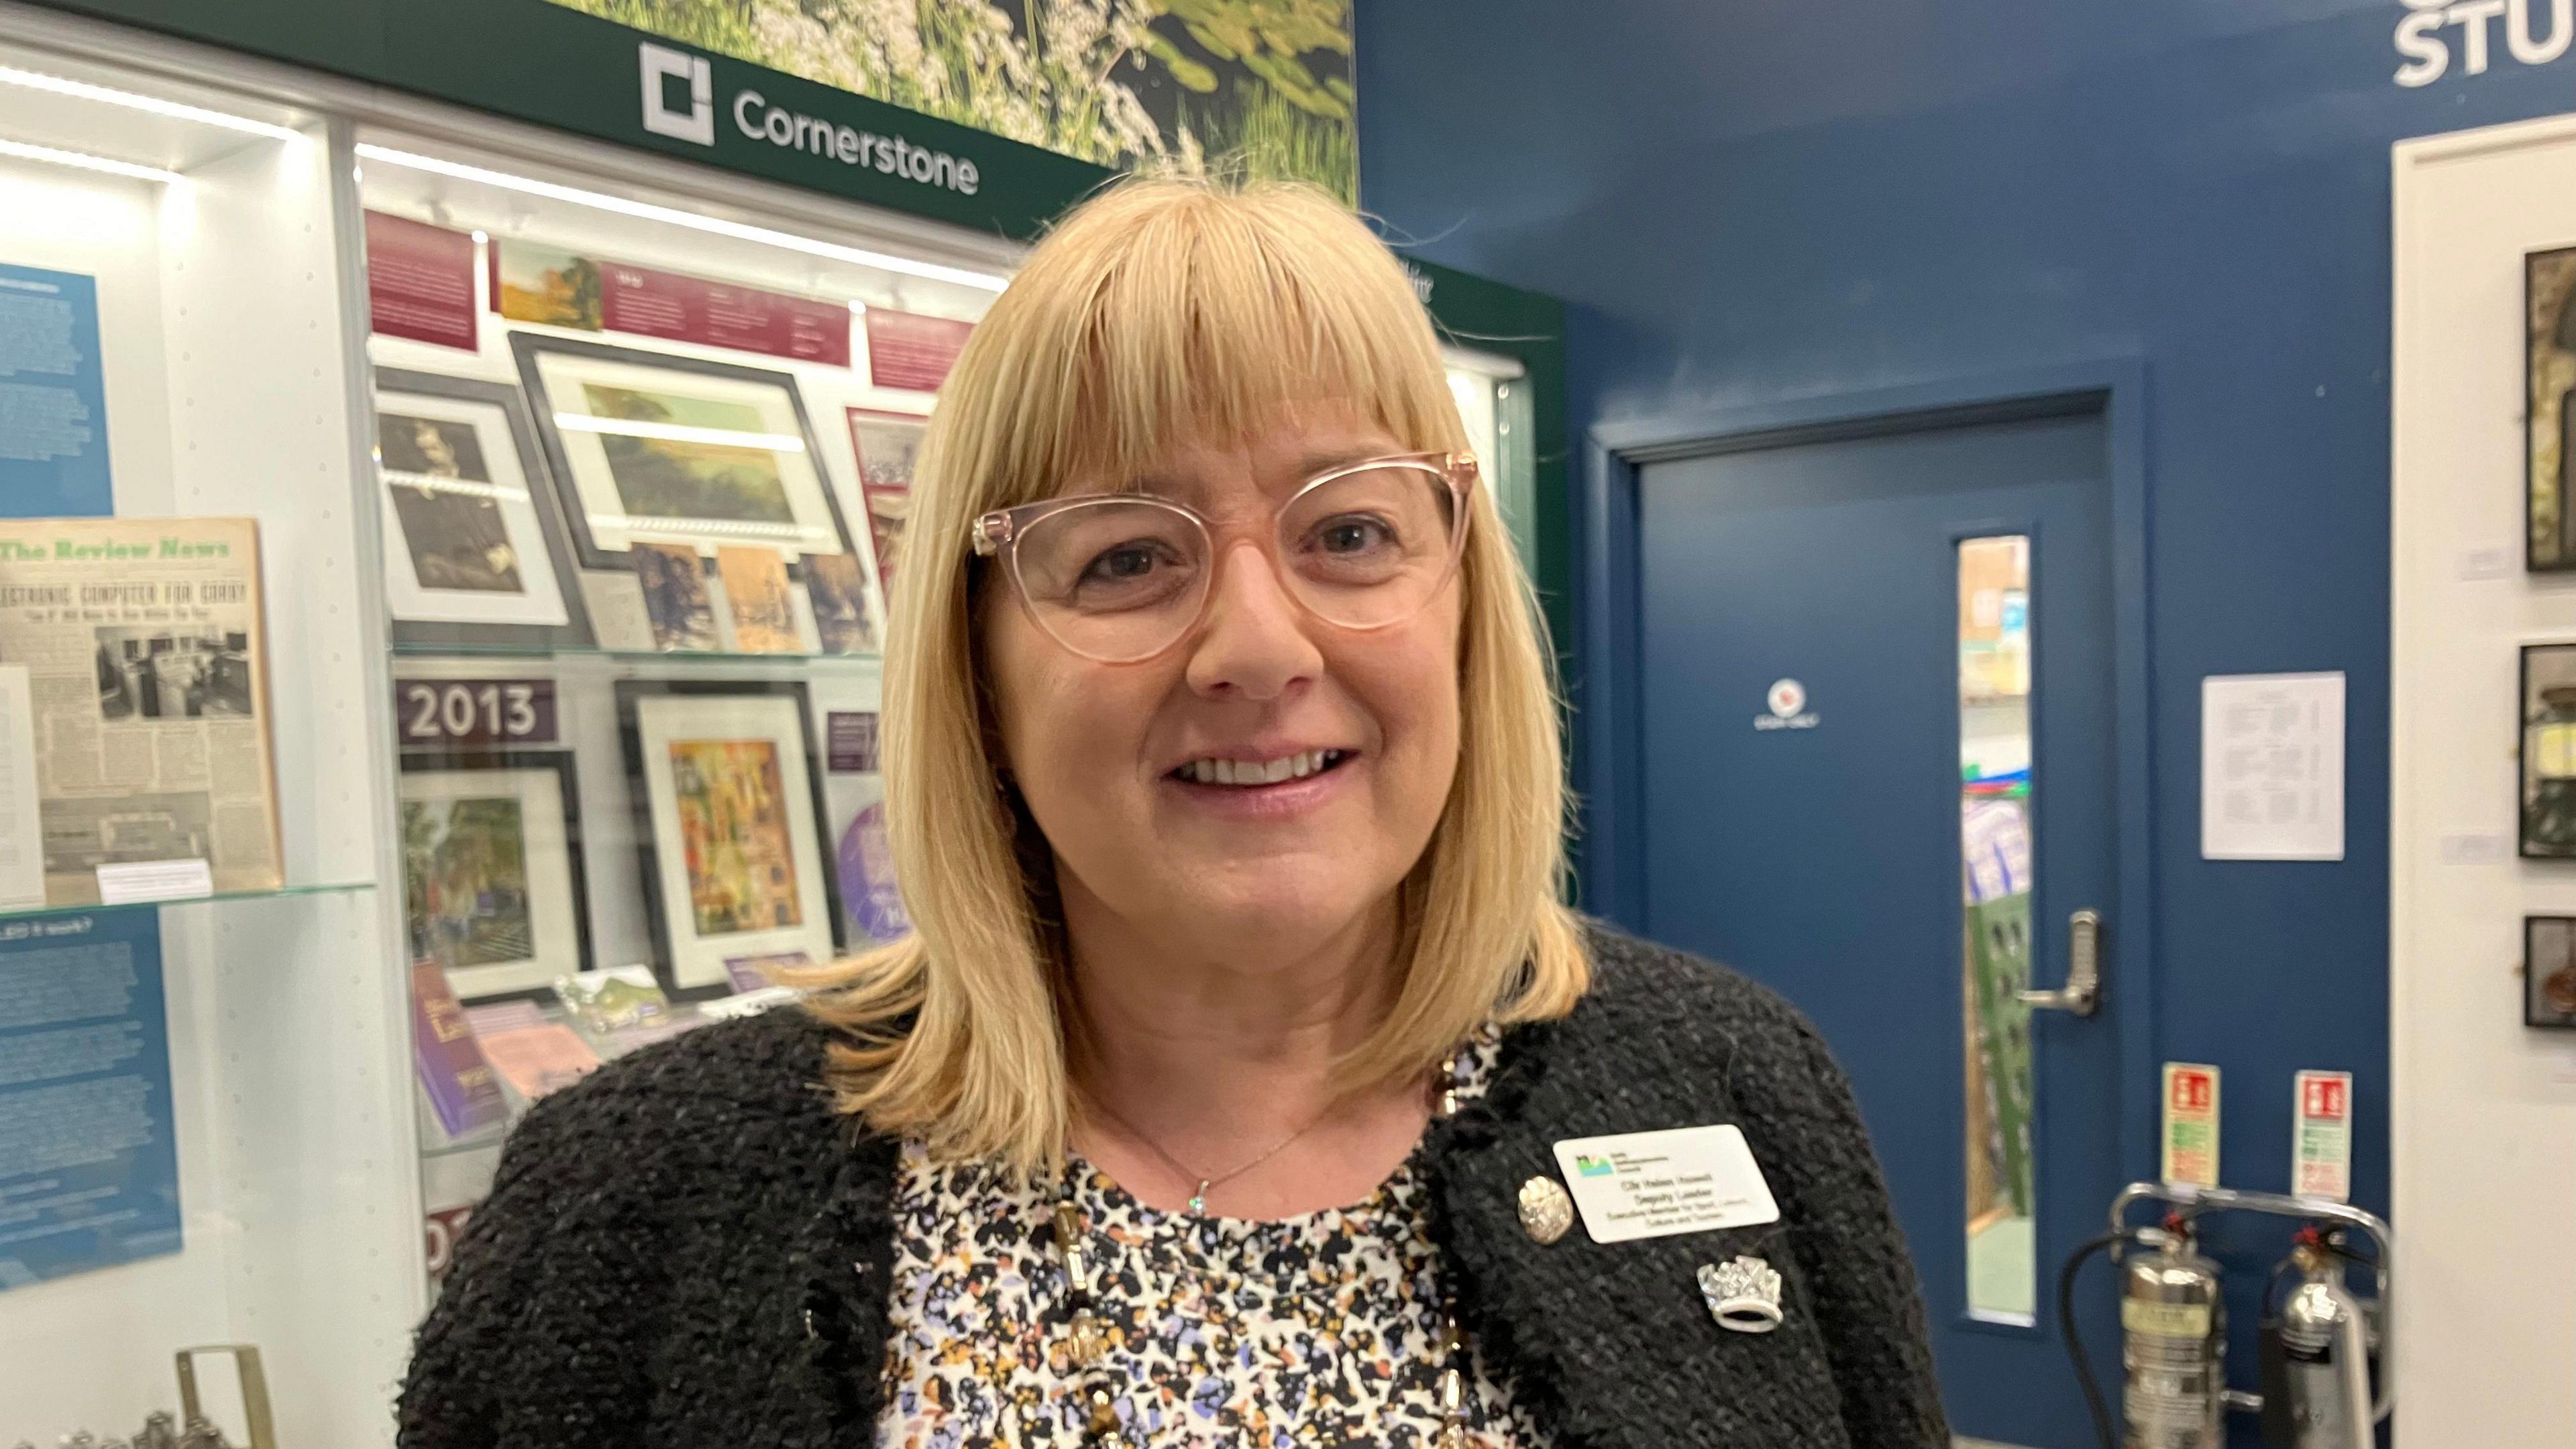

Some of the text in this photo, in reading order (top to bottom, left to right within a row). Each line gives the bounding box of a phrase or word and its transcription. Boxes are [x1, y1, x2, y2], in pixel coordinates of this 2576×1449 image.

[2393, 0, 2573, 88] STU
[733, 89, 979, 195] Cornerstone
[0, 538, 229, 559] The Review News
[80, 581, 157, 606] COMPUTER
[164, 580, 193, 604] FOR
[407, 683, 536, 737] 2013
